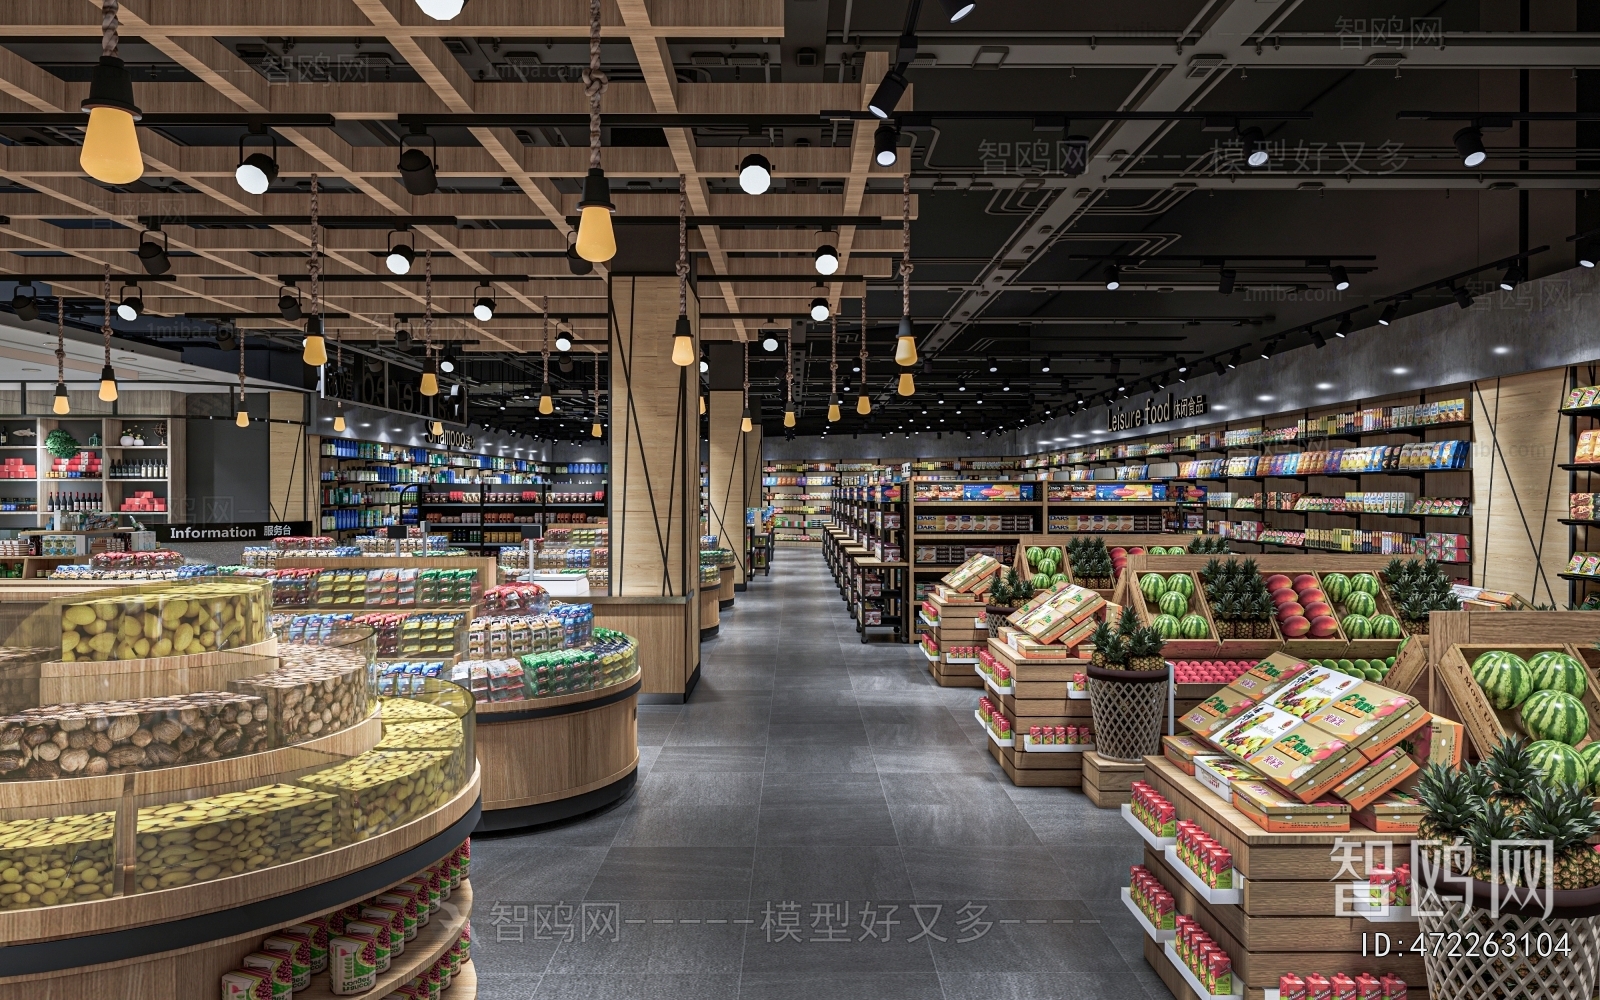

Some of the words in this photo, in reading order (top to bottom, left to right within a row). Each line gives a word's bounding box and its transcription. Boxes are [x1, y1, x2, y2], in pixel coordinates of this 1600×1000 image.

[1107, 406, 1141, 432] Leisure
[1145, 393, 1170, 424] food
[1173, 394, 1204, 419] 休闲食品
[170, 526, 256, 539] Information
[263, 524, 292, 537] 服务台
